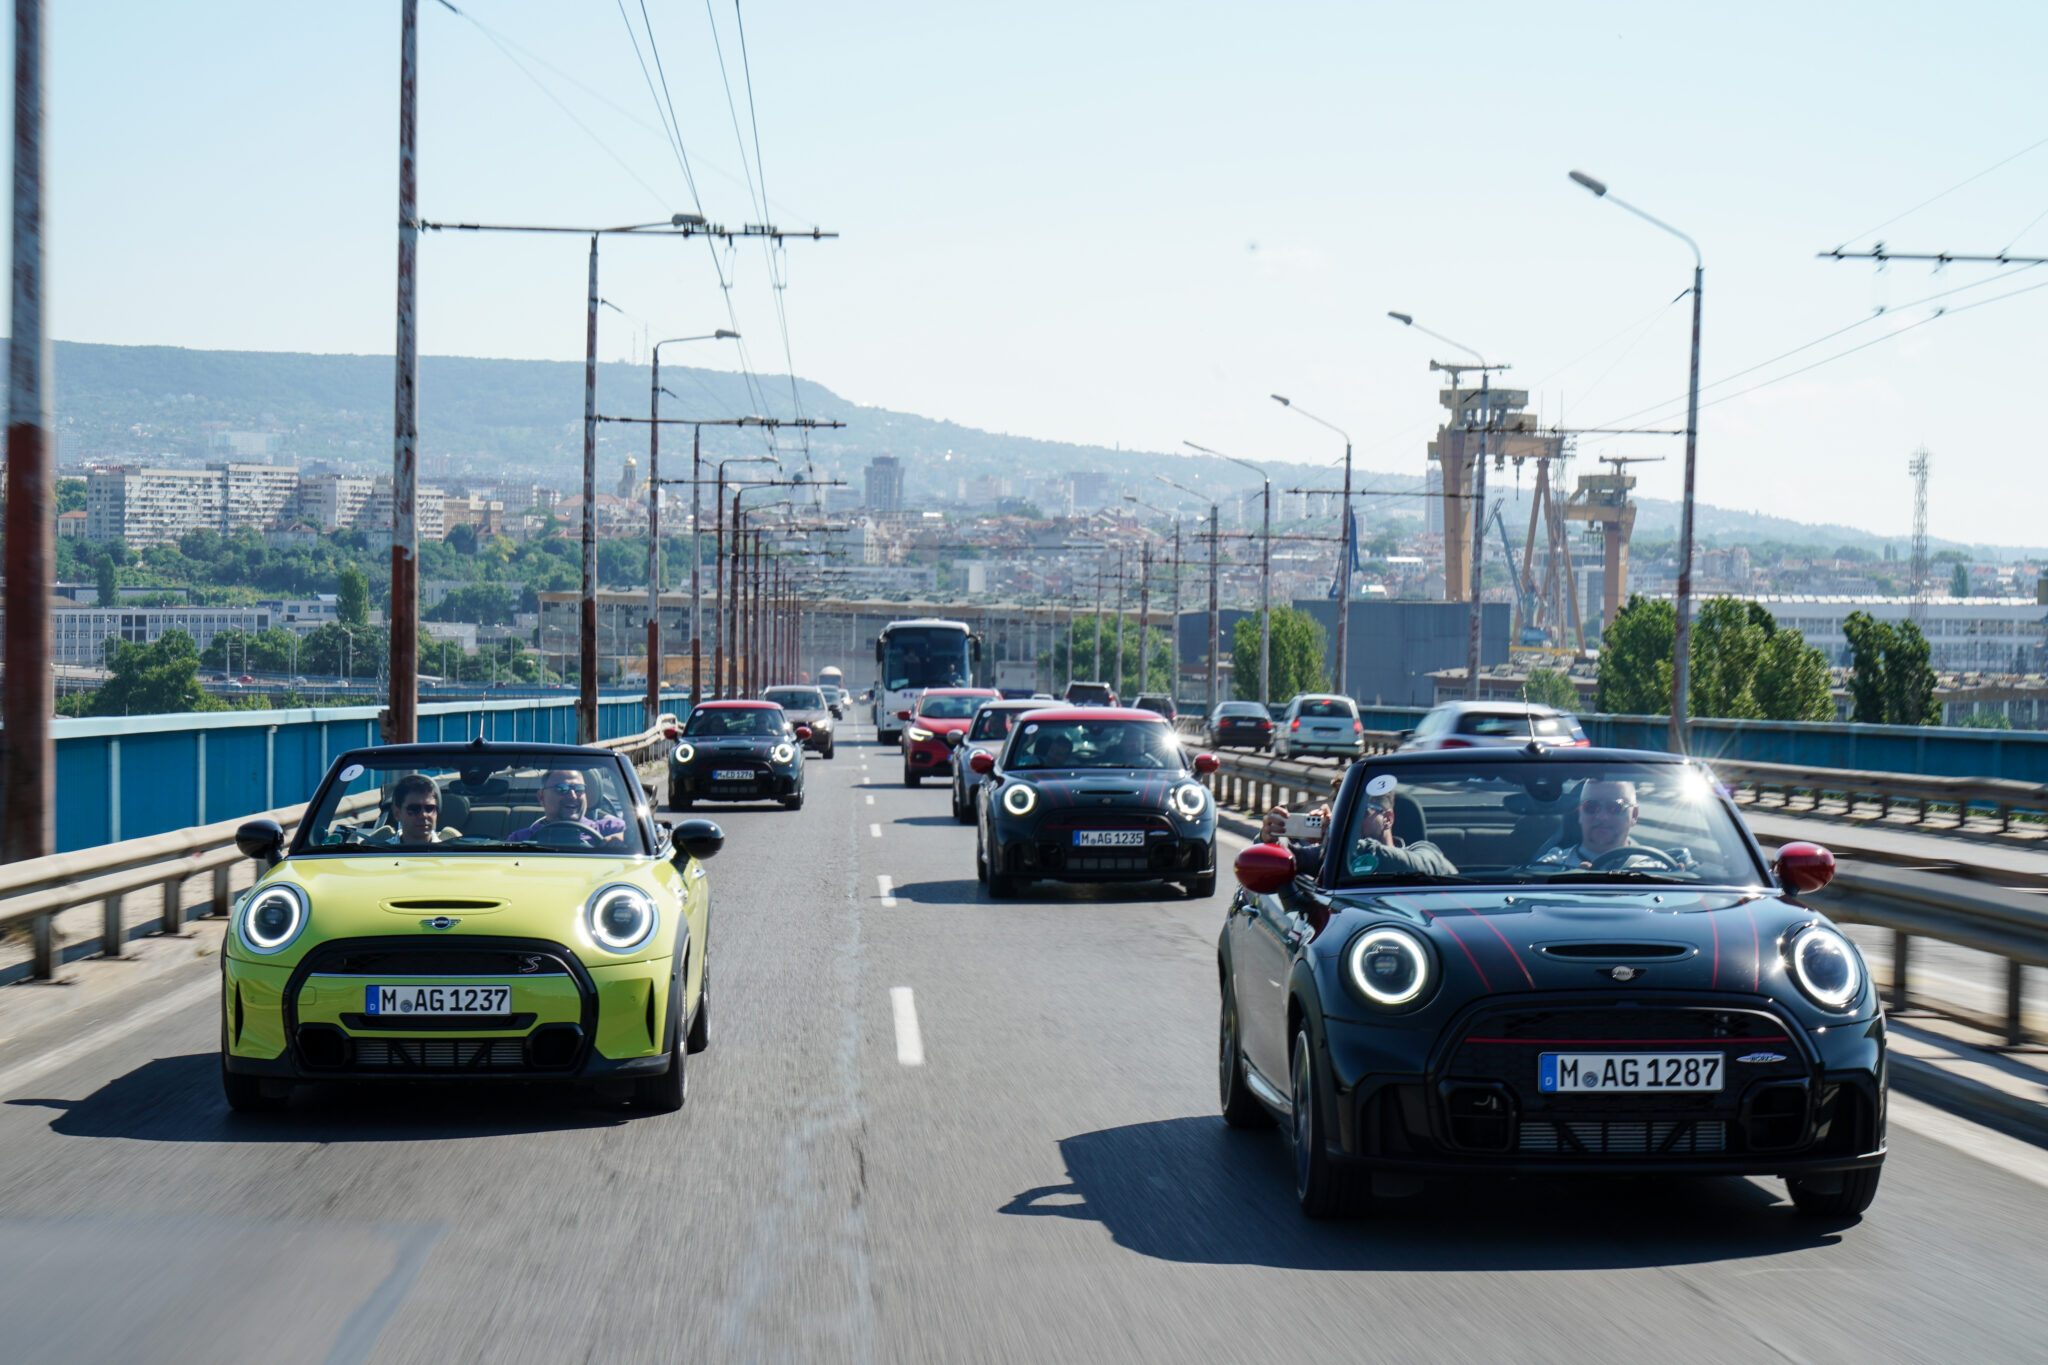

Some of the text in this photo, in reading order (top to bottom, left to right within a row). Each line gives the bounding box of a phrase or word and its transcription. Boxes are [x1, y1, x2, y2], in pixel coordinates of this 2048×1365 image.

[1081, 833, 1089, 844] M
[1097, 833, 1112, 844] AG
[1114, 833, 1143, 844] 1235
[521, 956, 541, 972] S
[369, 1003, 376, 1011] D
[381, 989, 508, 1011] M AG 1237
[1560, 1058, 1720, 1087] M AG 1287
